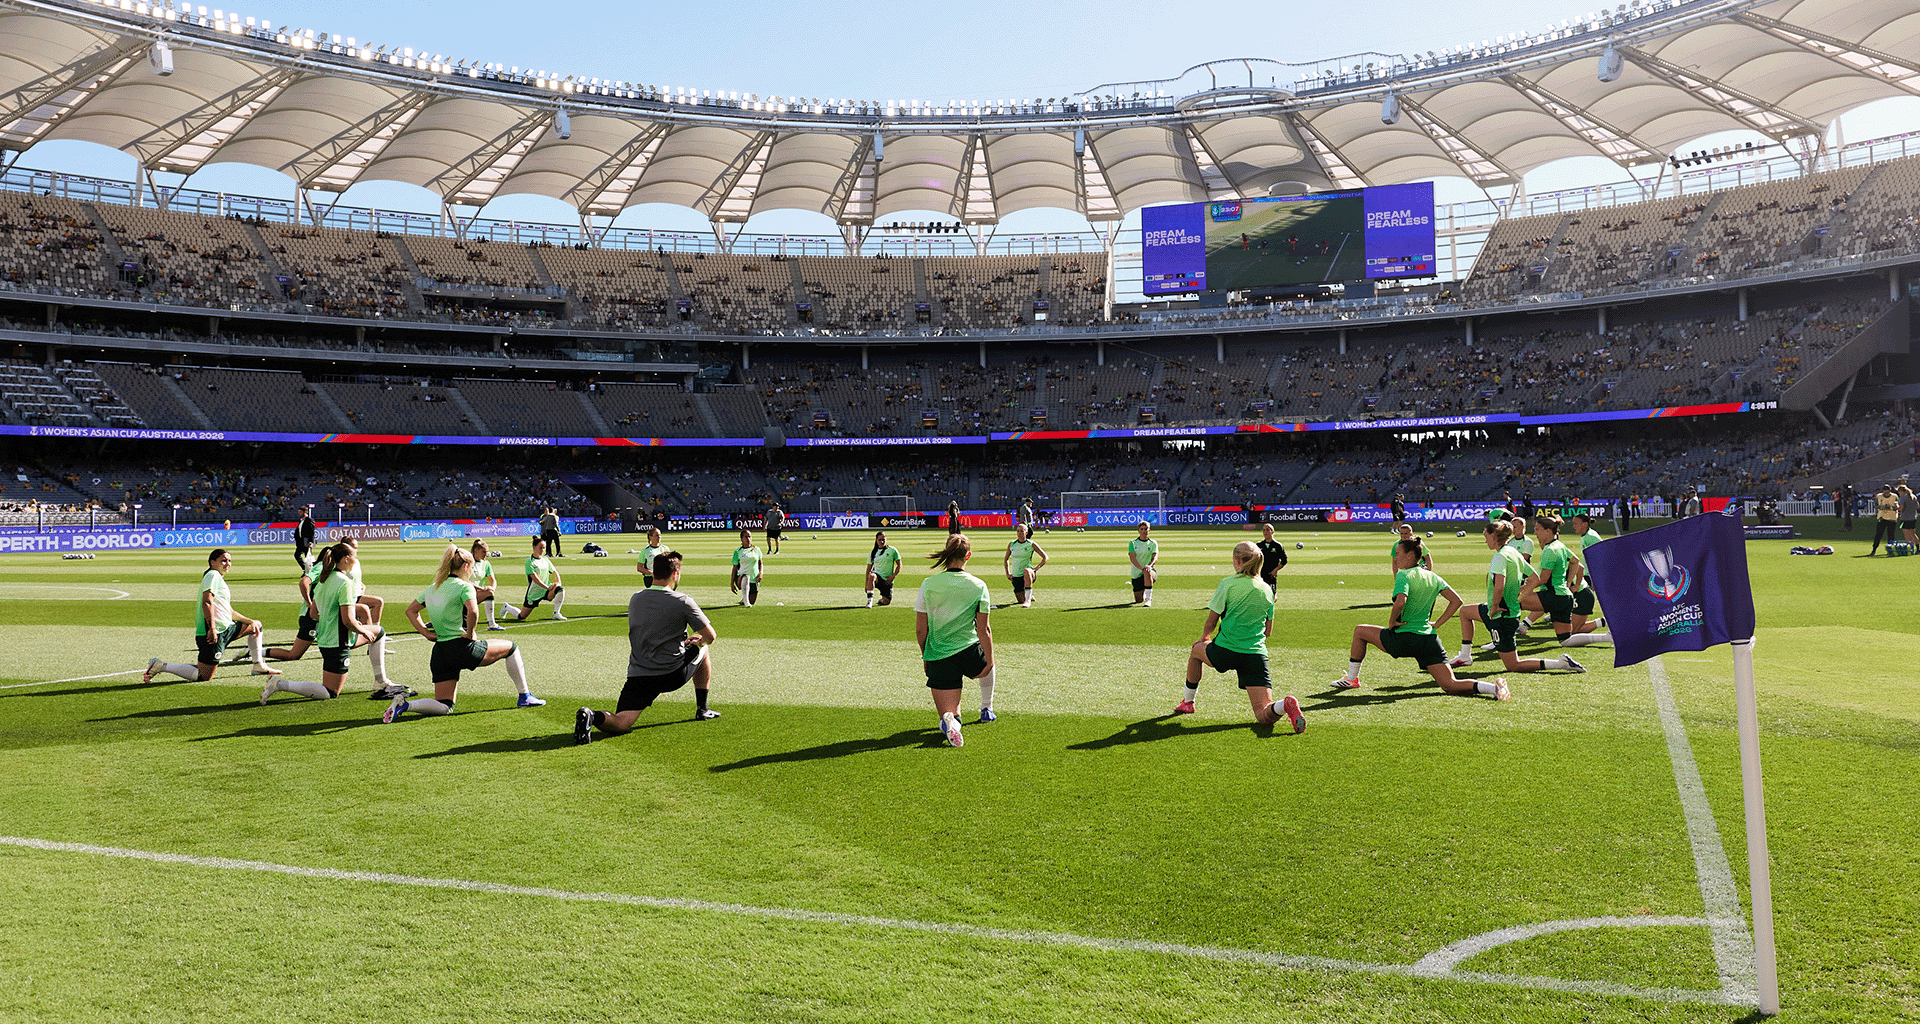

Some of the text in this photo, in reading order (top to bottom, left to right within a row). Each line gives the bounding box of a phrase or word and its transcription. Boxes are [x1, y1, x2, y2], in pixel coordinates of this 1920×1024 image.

[1367, 209, 1411, 220] DREAM
[1367, 216, 1429, 229] FEARLESS
[1145, 229, 1185, 239] DREAM
[1146, 235, 1201, 247] FEARLESS
[1766, 401, 1777, 409] PM
[1379, 420, 1401, 428] ASIAN
[1418, 417, 1464, 426] AUSTRALIA
[44, 427, 88, 437] WOMEN'S
[90, 429, 119, 438] ASIAN
[120, 430, 138, 438] CUP
[139, 430, 198, 440] AUSTRALIA
[199, 432, 224, 440] 2026
[1133, 427, 1207, 437] DREAM FEARLESS
[1168, 512, 1248, 523] CREDIT SAISON
[1269, 511, 1318, 522] Football Cares
[1350, 511, 1371, 520] AFC
[1373, 511, 1399, 520] Asia
[1536, 507, 1606, 518] AFC LIVE APP
[683, 520, 725, 529] HOSTPLUS
[735, 519, 763, 528] QATAR
[805, 518, 828, 528] VISA
[840, 517, 863, 527] VISA
[889, 518, 927, 526] CommBank
[1095, 514, 1145, 524] OXAGON
[575, 521, 622, 532] CREDIT SAISON
[165, 532, 223, 545] OXAGON
[249, 530, 328, 543] CREDIT SON
[329, 527, 400, 540] QATAR AIRWAYS
[0, 535, 59, 551] PERTH
[72, 533, 153, 549] BOORLOO
[1673, 602, 1685, 611] AFC
[1659, 604, 1701, 622] WOMEN'S
[1683, 611, 1704, 621] CUP
